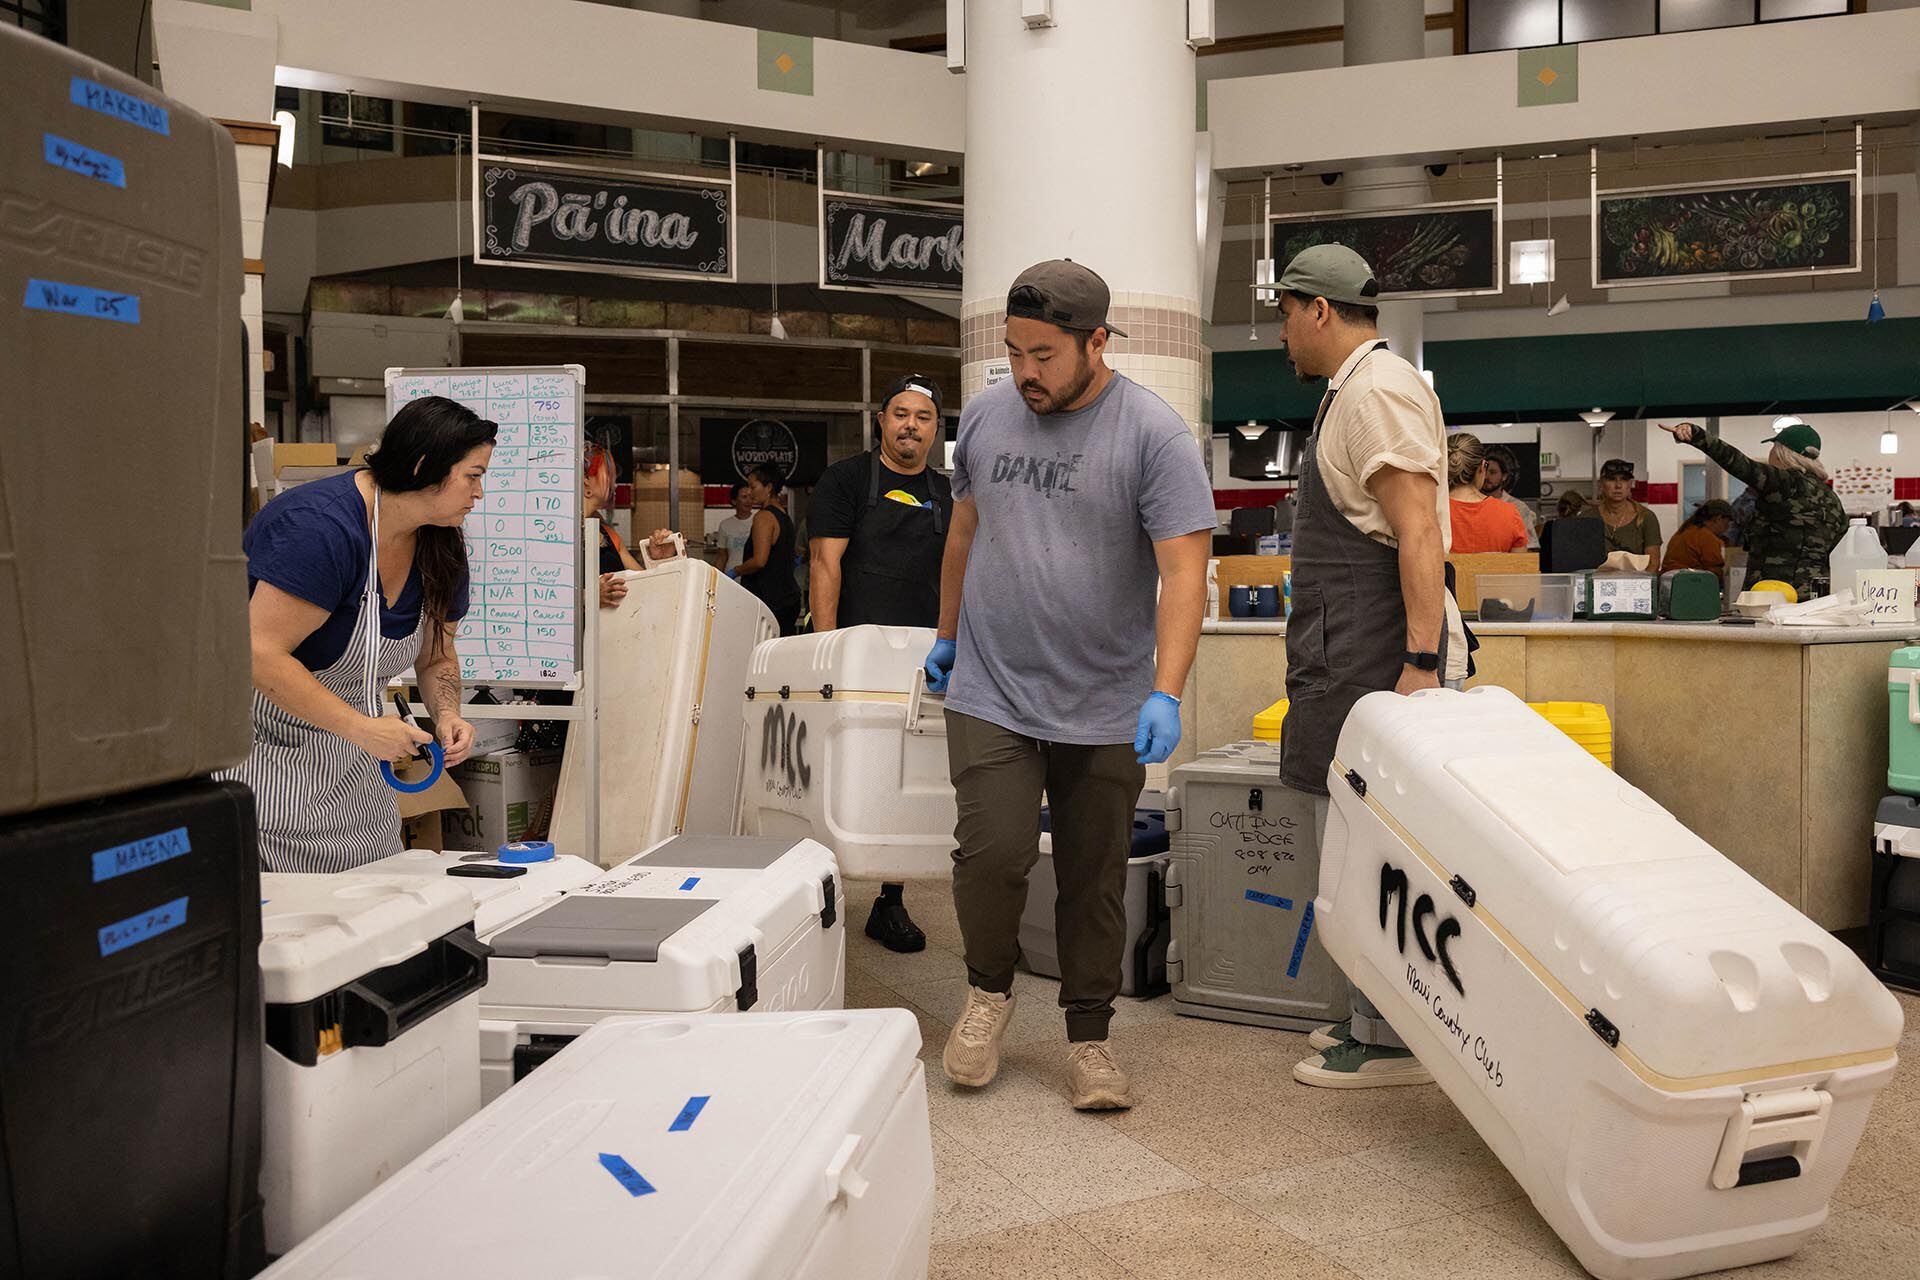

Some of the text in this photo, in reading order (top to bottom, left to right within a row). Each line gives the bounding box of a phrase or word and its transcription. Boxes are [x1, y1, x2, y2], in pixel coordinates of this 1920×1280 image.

[534, 400, 560, 411] 750
[533, 425, 558, 436] 375
[538, 471, 560, 484] 50
[497, 496, 506, 508] 0
[535, 496, 561, 510] 170
[495, 519, 505, 532] 0
[533, 519, 556, 534] 50
[490, 542, 523, 557] 2500
[489, 586, 515, 600] N/A
[533, 587, 558, 601] N/A
[1861, 579, 1898, 601] Clean
[492, 624, 512, 636] 150
[536, 627, 557, 637] 150
[464, 657, 475, 667] 0
[505, 657, 515, 667] 0
